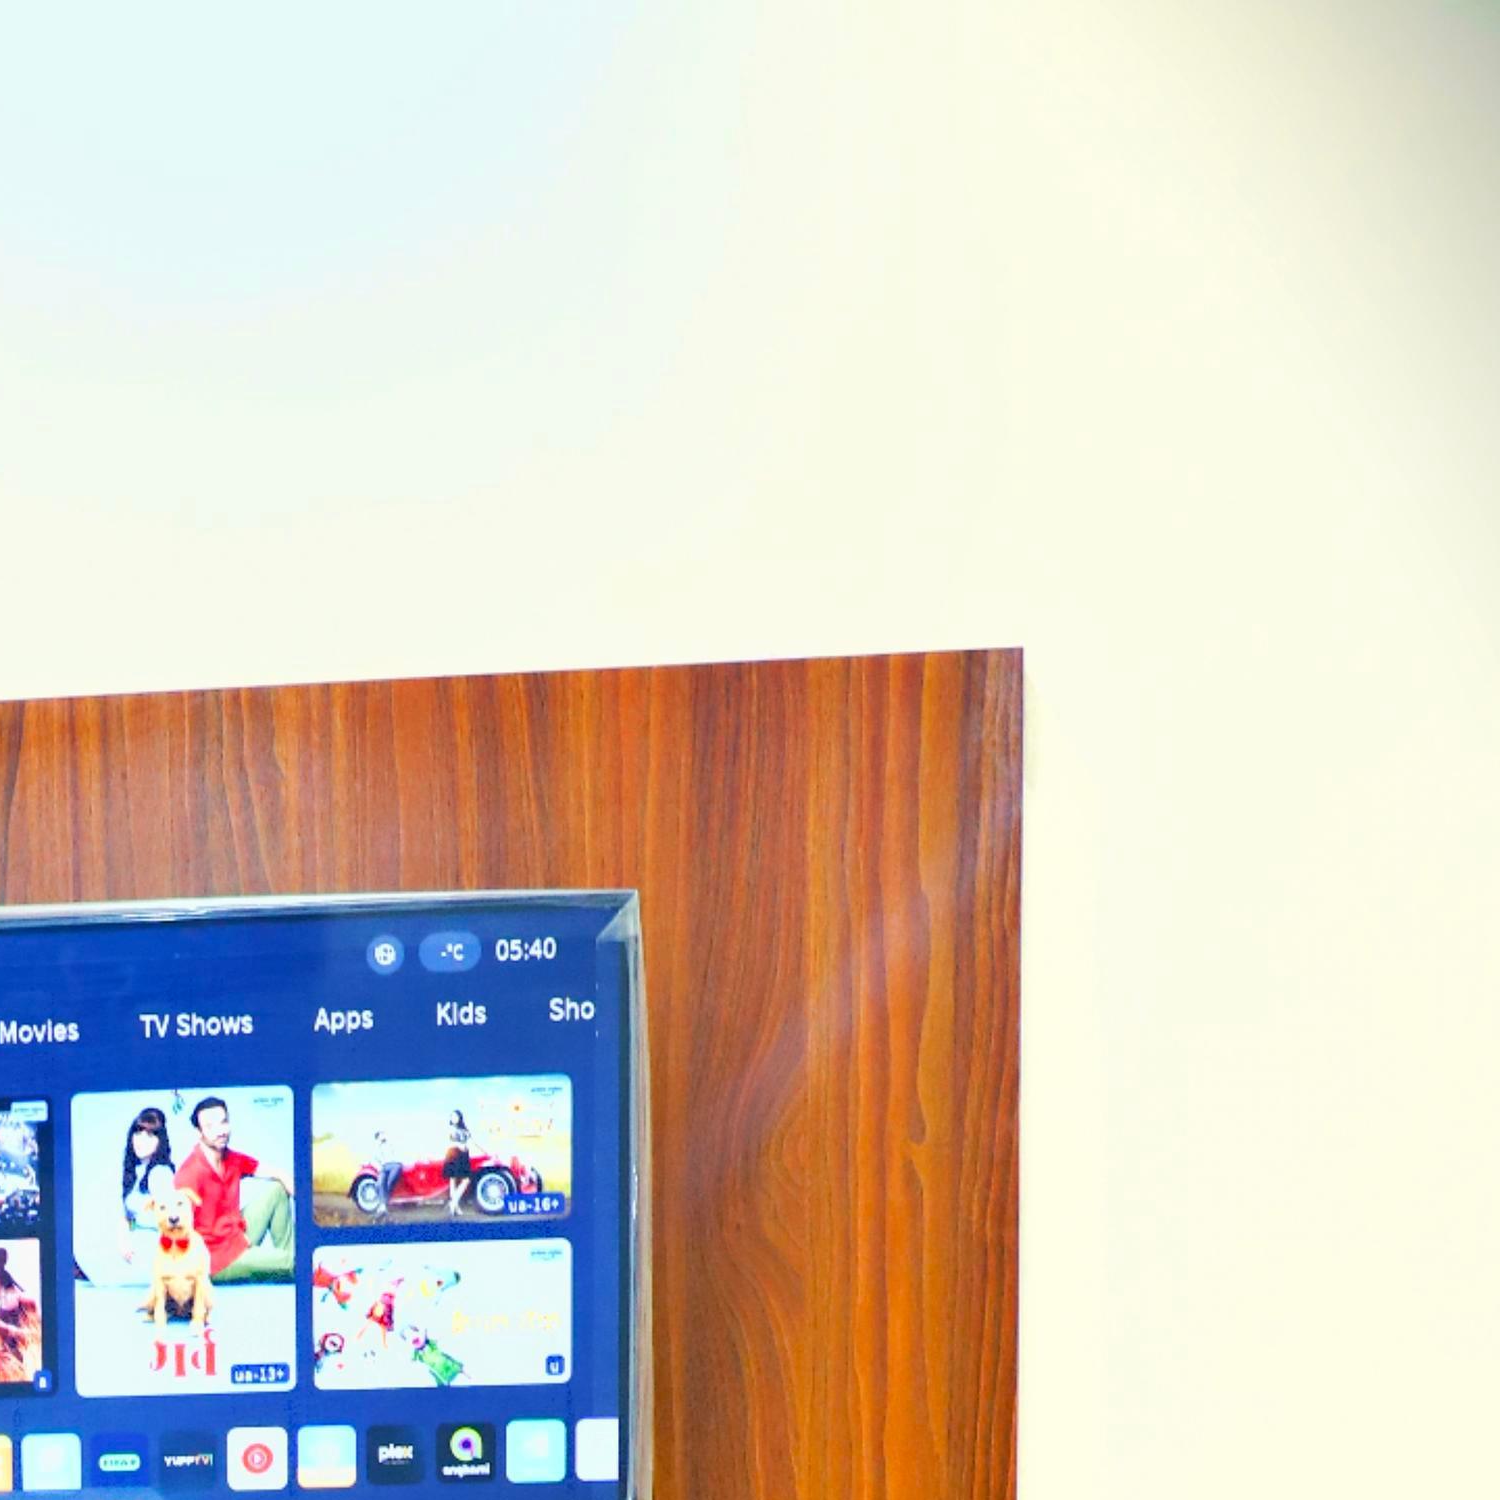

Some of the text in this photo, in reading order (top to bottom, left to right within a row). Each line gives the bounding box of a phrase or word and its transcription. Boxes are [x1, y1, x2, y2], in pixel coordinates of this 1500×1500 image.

[495, 937, 558, 962] 05:40
[313, 1006, 375, 1035] Apps
[435, 1000, 488, 1027] Kids
[548, 997, 596, 1022] Sho
[139, 1011, 254, 1039] TV Shows
